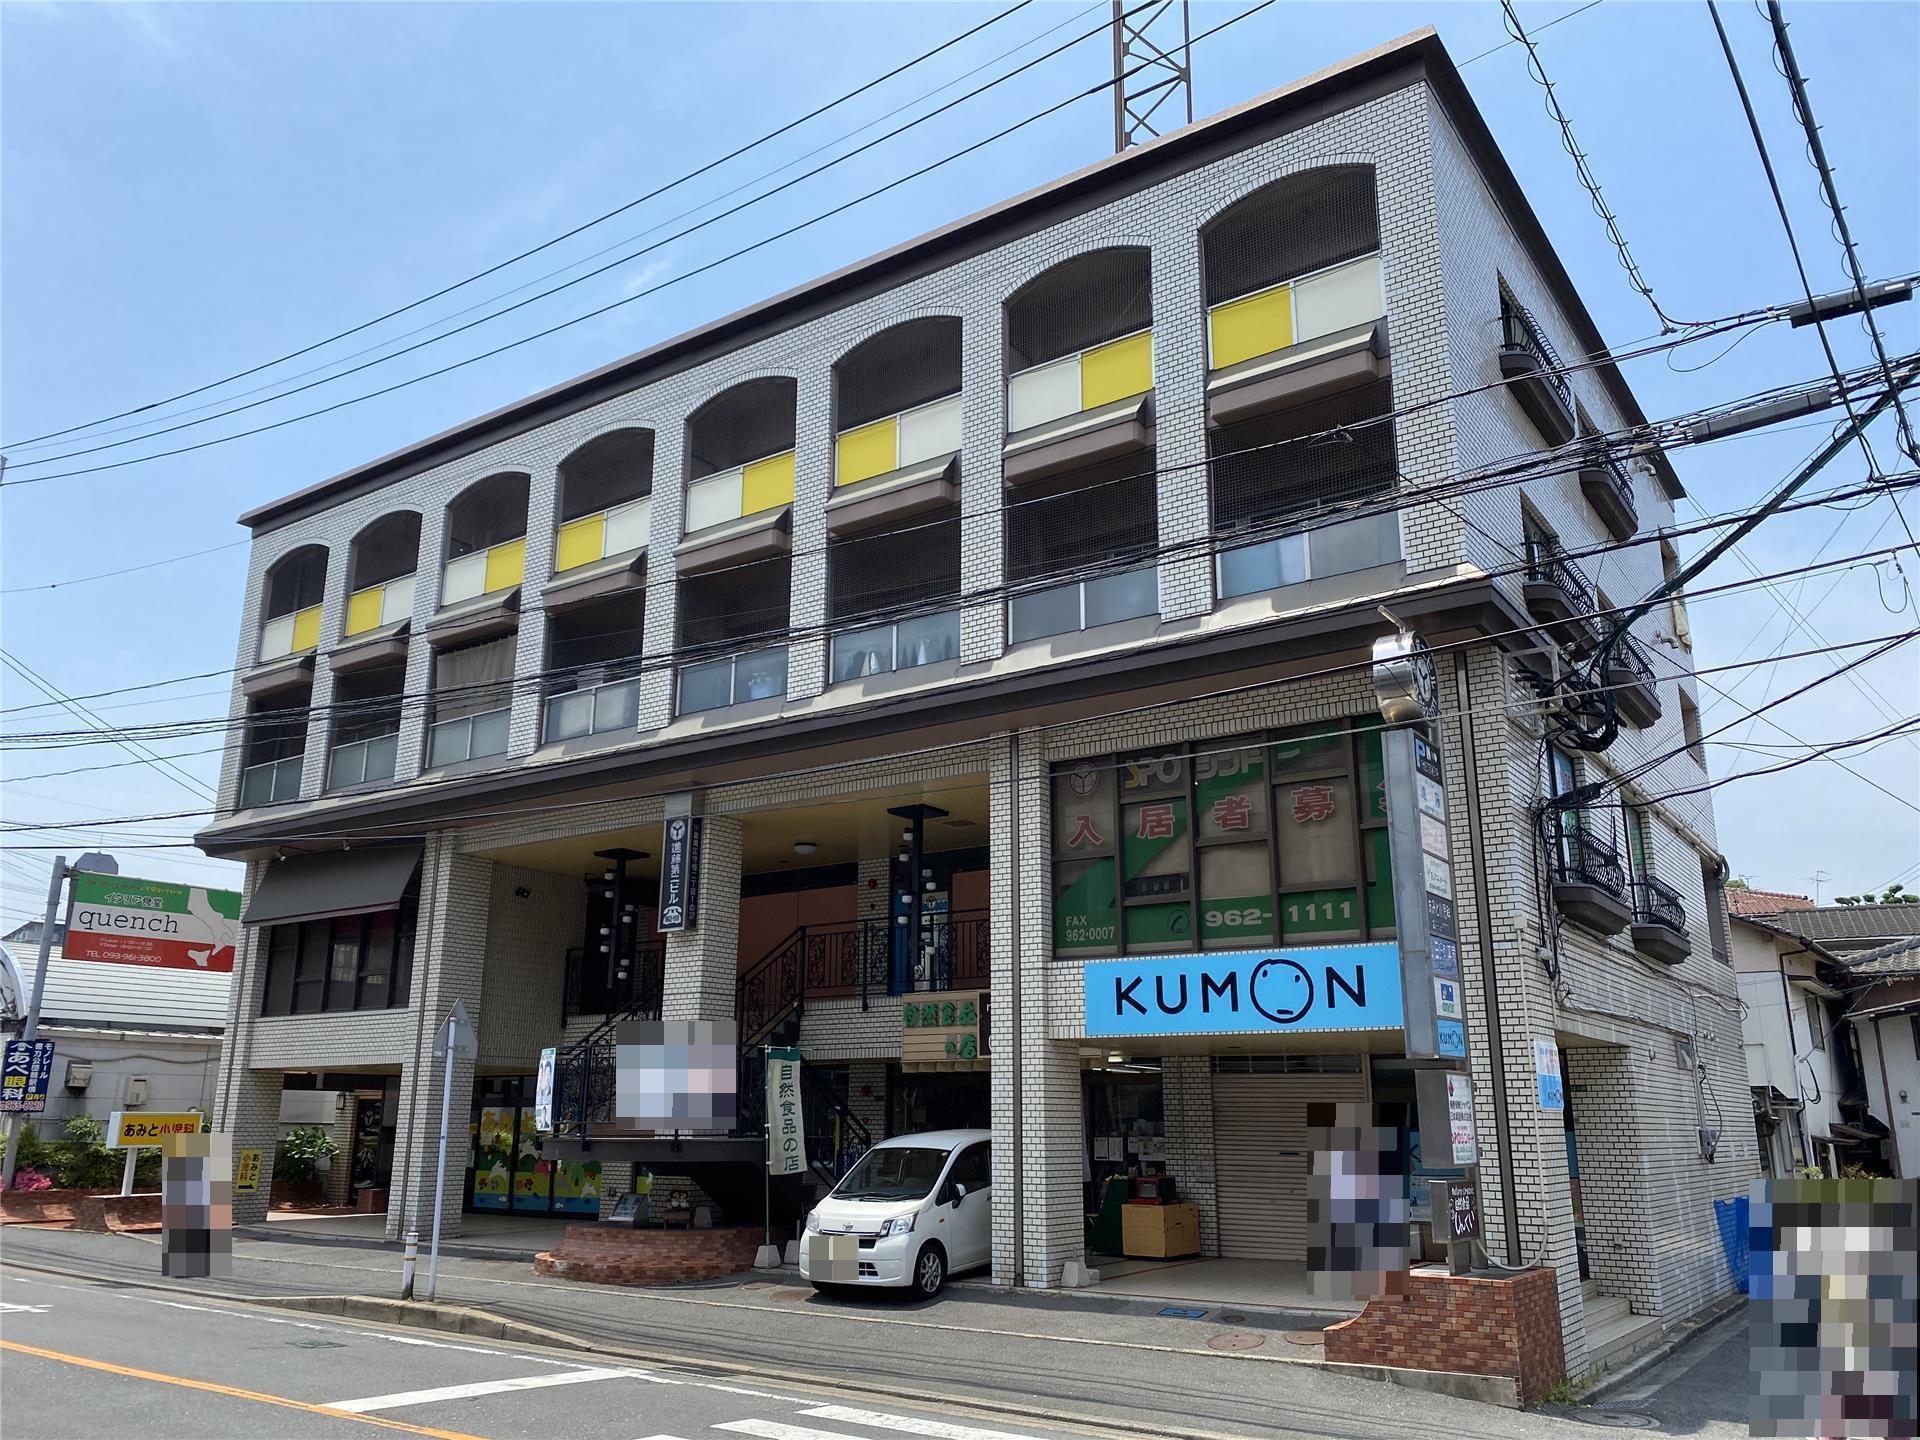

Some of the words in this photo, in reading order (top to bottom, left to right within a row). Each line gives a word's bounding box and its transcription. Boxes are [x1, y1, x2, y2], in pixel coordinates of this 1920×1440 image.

[1066, 780, 1388, 848] 入居者募
[104, 892, 164, 909] イタリア食堂
[79, 910, 178, 933] quench
[1065, 915, 1087, 927] FAX
[1205, 901, 1352, 928] 962-1111
[86, 950, 100, 958] TEL
[102, 951, 162, 963] 093-961-3800
[1115, 958, 1367, 1024] KUMON
[904, 1000, 977, 1027] 自然食品
[1439, 1030, 1464, 1049] KUMON
[39, 1043, 53, 1079] モノレール
[2, 1051, 30, 1100] あべ眼科
[124, 1123, 194, 1137] あみと小児科
[778, 1064, 800, 1172] 自然食品の店
[239, 1153, 251, 1181] 小児科
[248, 1153, 260, 1181] あみと
